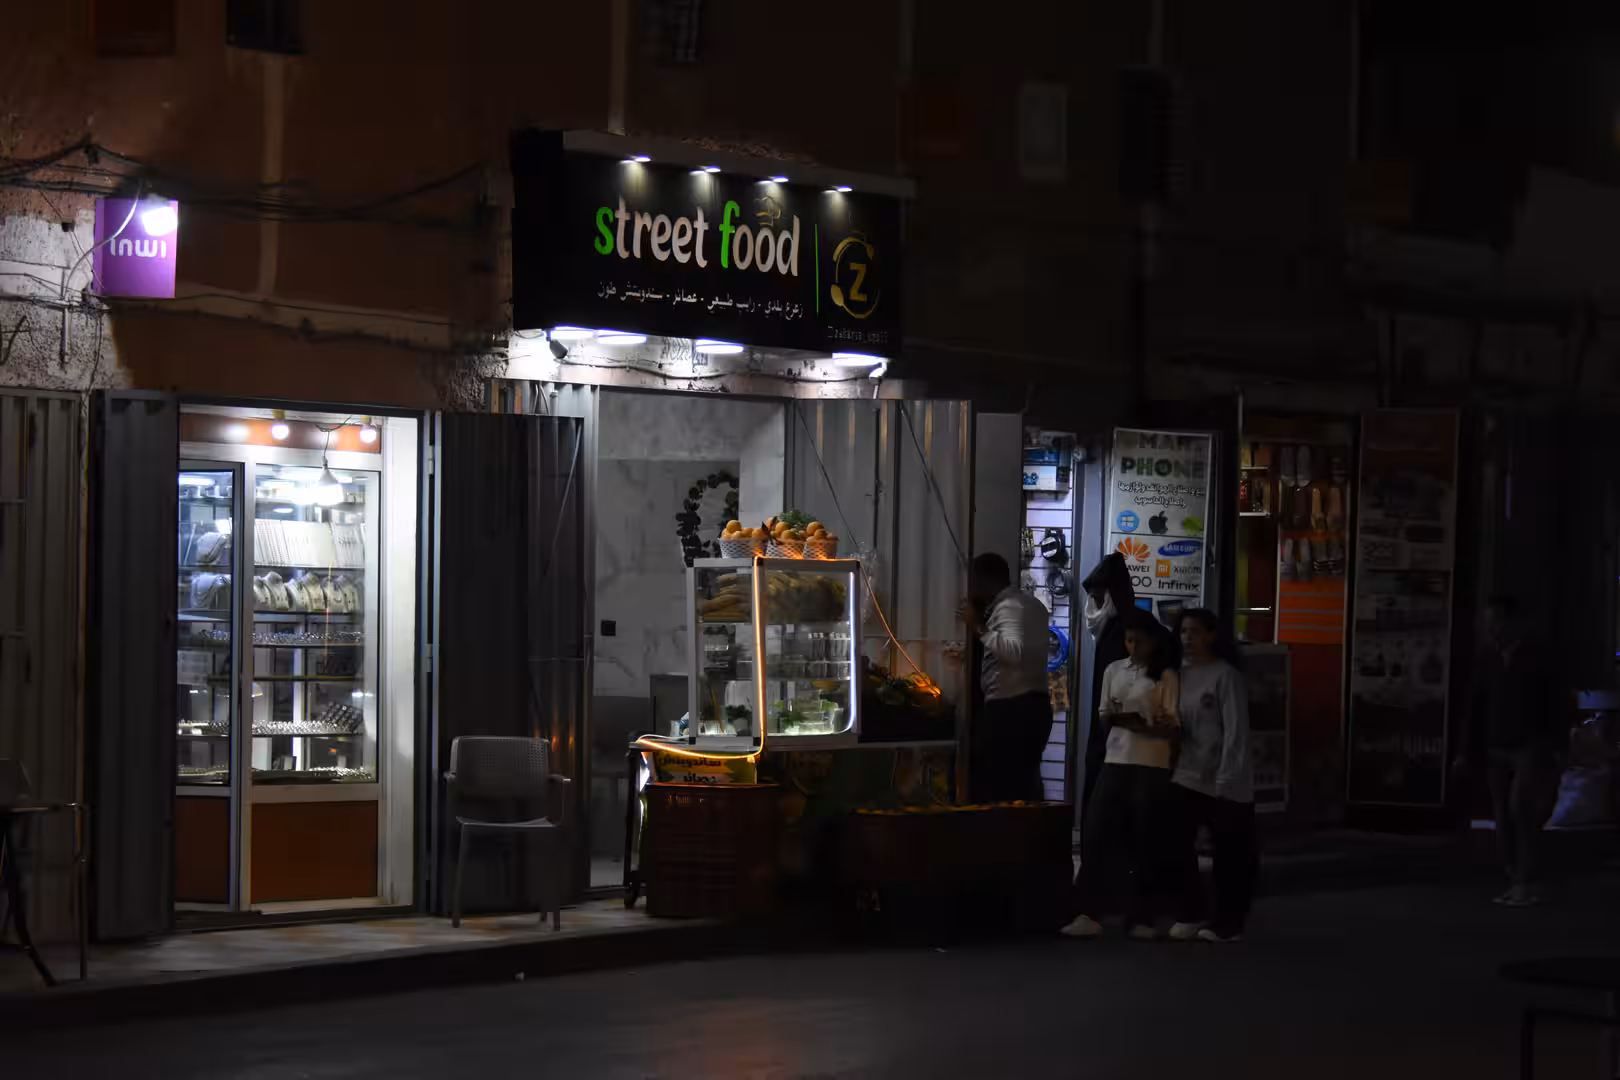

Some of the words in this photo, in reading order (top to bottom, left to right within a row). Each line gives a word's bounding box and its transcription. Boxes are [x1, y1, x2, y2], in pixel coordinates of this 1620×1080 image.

[593, 194, 709, 269] street
[719, 199, 800, 277] food
[110, 238, 167, 259] inwi
[1120, 456, 1205, 479] PHONE
[1164, 542, 1199, 553] SAMSUN
[1127, 563, 1151, 574] AWEI
